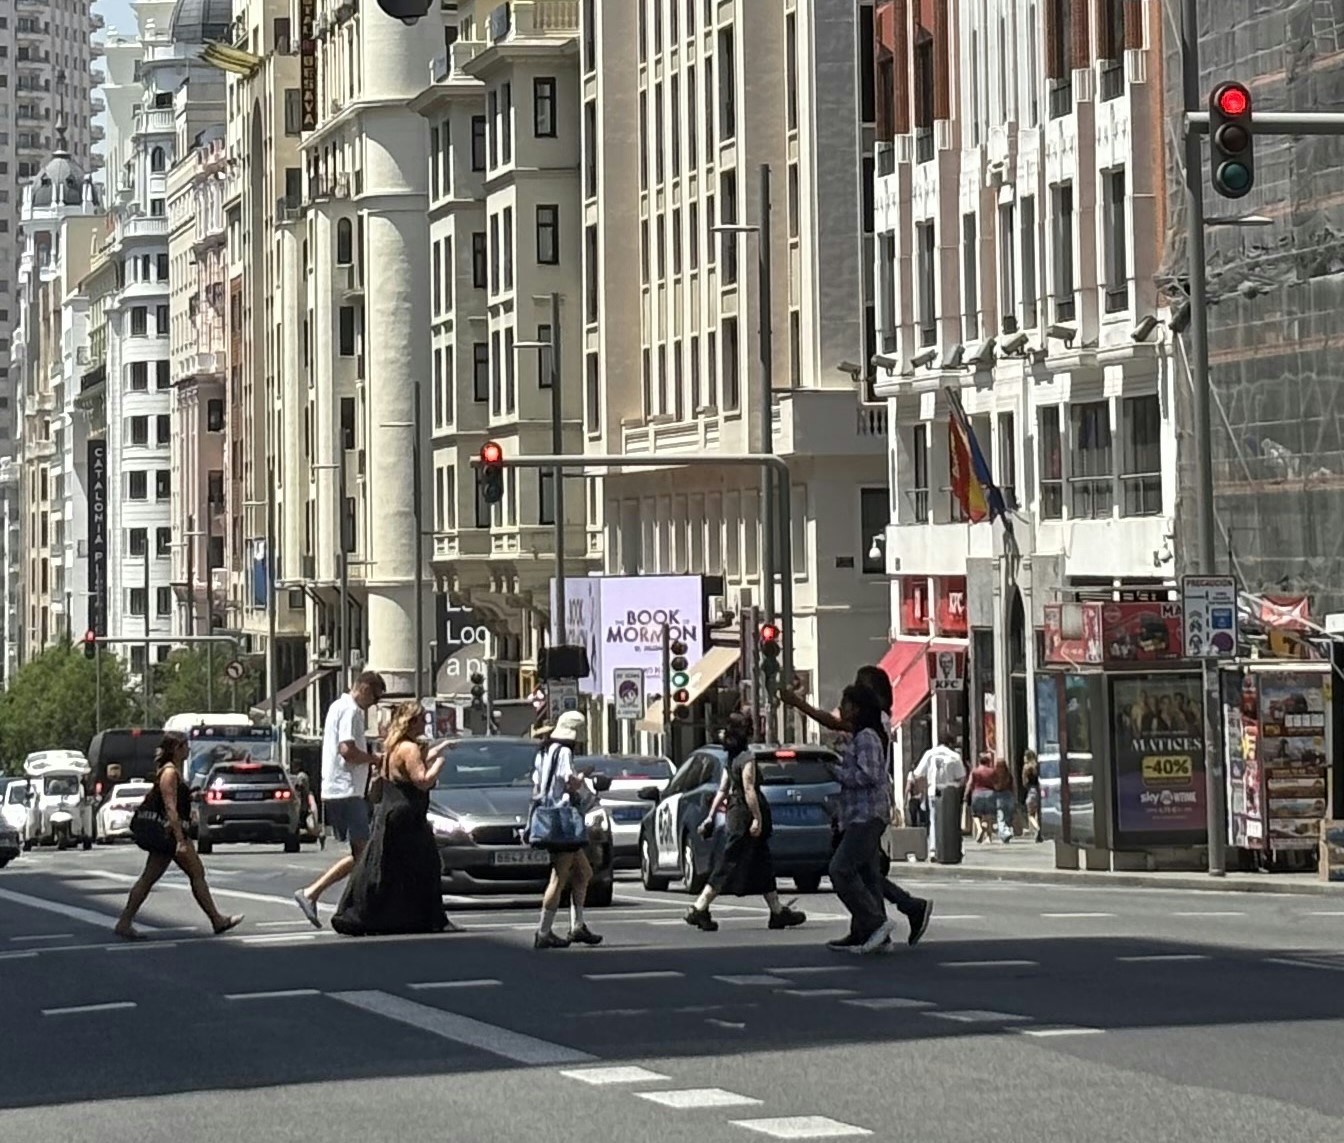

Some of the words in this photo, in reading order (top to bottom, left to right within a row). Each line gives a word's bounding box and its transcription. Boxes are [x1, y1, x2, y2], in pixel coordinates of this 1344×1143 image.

[94, 447, 104, 544] CATALONIA
[627, 609, 680, 625] BOOK
[606, 625, 697, 643] MORMON
[935, 679, 960, 689] KFC
[1131, 737, 1202, 752] MATICES
[1145, 759, 1189, 775] -40%
